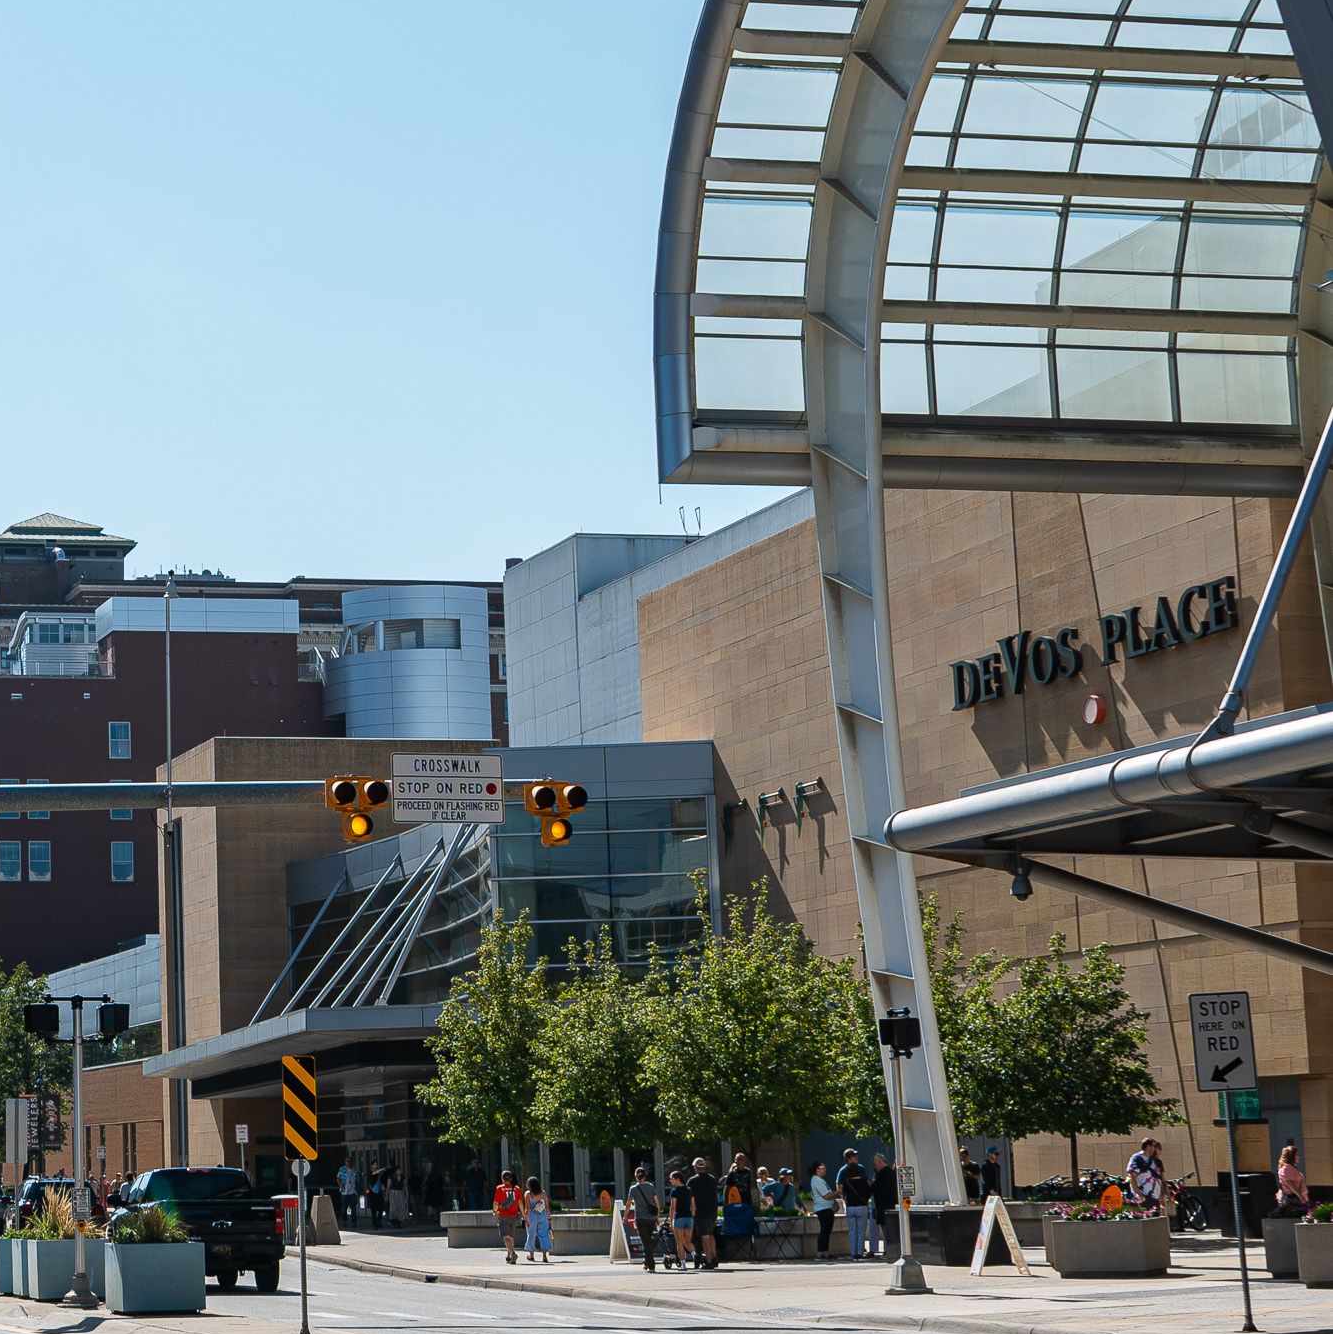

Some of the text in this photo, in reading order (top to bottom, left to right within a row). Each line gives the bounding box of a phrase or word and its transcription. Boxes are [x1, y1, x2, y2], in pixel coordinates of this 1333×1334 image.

[1098, 575, 1240, 666] PLACE
[414, 759, 481, 773] CROSSWALK
[398, 782, 483, 794] STOP ON RED
[397, 801, 499, 811] PROCEED ON FLASHING RED
[432, 811, 466, 820] IF CLEAR
[1199, 1000, 1240, 1016] STOP
[1198, 1020, 1245, 1032] HERE ON
[1207, 1036, 1239, 1052] RED
